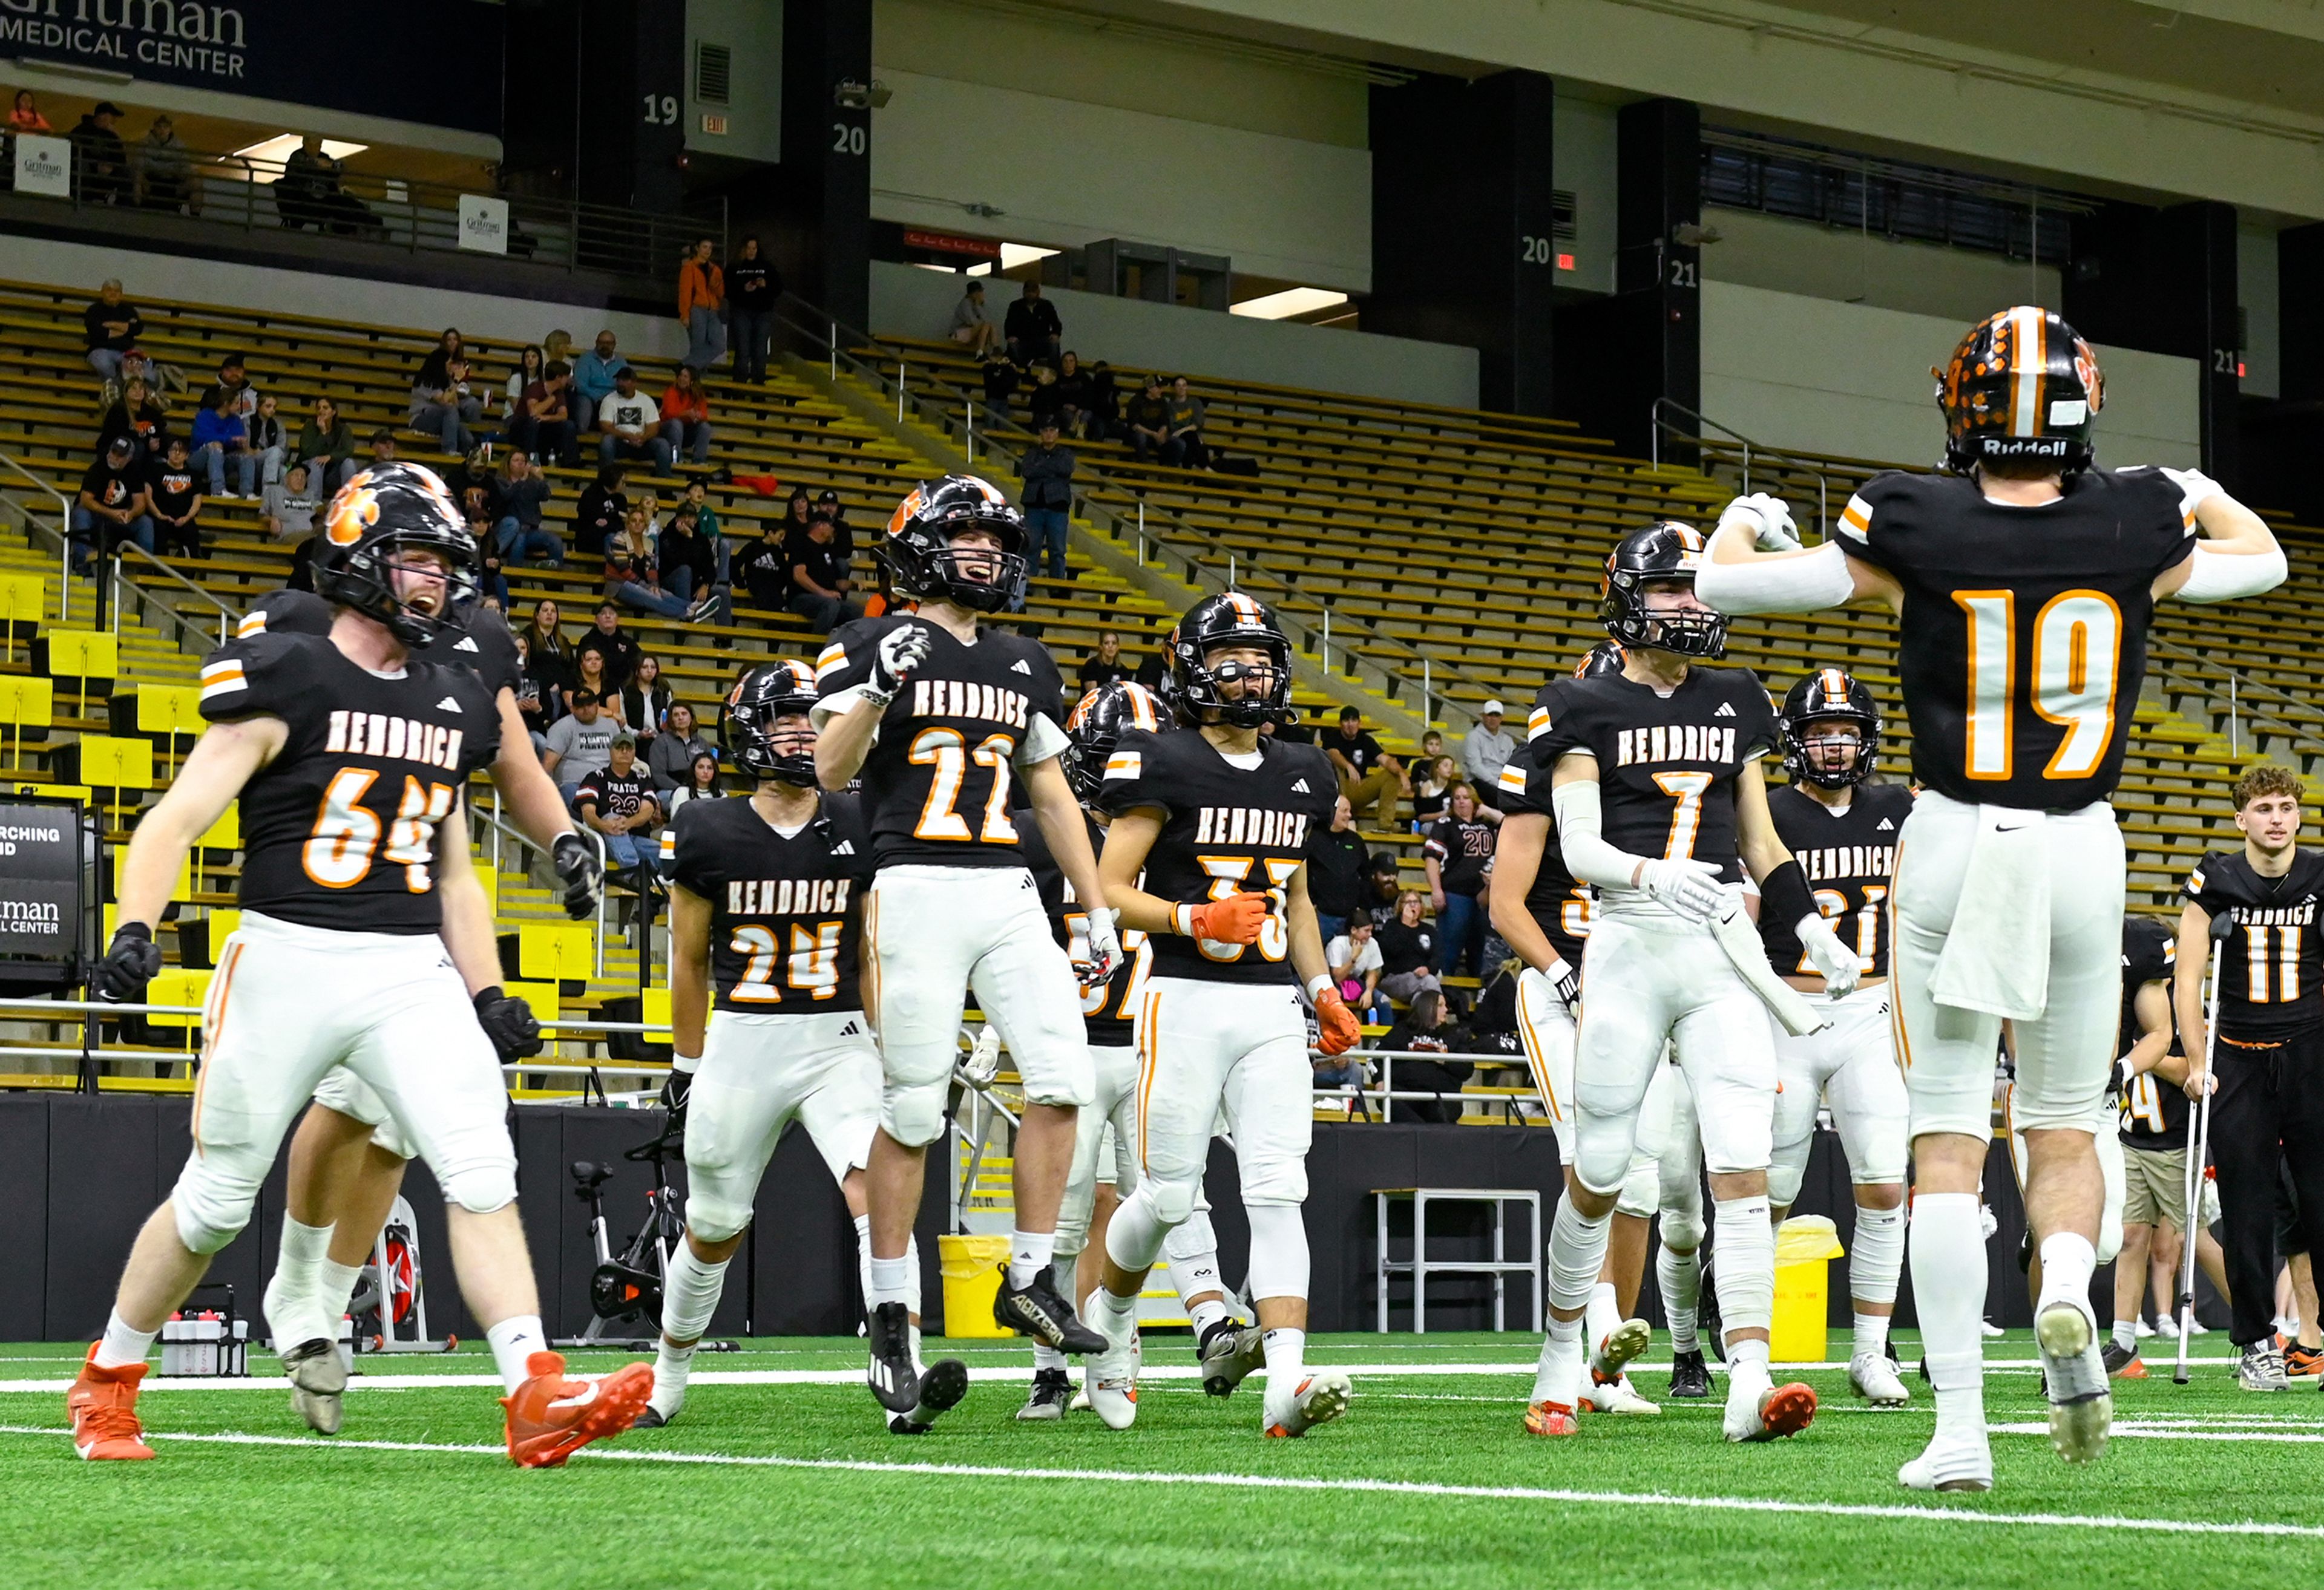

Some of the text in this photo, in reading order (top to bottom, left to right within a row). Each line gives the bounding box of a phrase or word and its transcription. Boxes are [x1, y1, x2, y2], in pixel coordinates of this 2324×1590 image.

[0, 16, 245, 79] MEDICAL CENTER
[643, 93, 678, 125] 19
[833, 123, 865, 155] 20
[1522, 236, 1549, 264] 20
[1671, 260, 1696, 287] 21
[2214, 348, 2236, 374] 21
[1983, 439, 2067, 456] Riddell
[1951, 588, 2123, 781] 19
[911, 679, 1029, 730] KENDRICK
[324, 710, 463, 771] KENDRICK
[1617, 725, 1736, 767] KENDRICK
[607, 781, 639, 793] PIRATES
[908, 726, 1020, 845] 22
[301, 766, 453, 894] 64
[1193, 806, 1307, 848] KENDRICK
[1650, 770, 1713, 860] 7
[1463, 829, 1494, 857] 20
[1796, 845, 1894, 881] KENDRICK
[727, 879, 852, 915] KENDRICK
[2231, 904, 2316, 926] KENDRICK
[10, 921, 59, 935] CENTER
[729, 920, 844, 1004] 24
[2242, 926, 2302, 1004] 11
